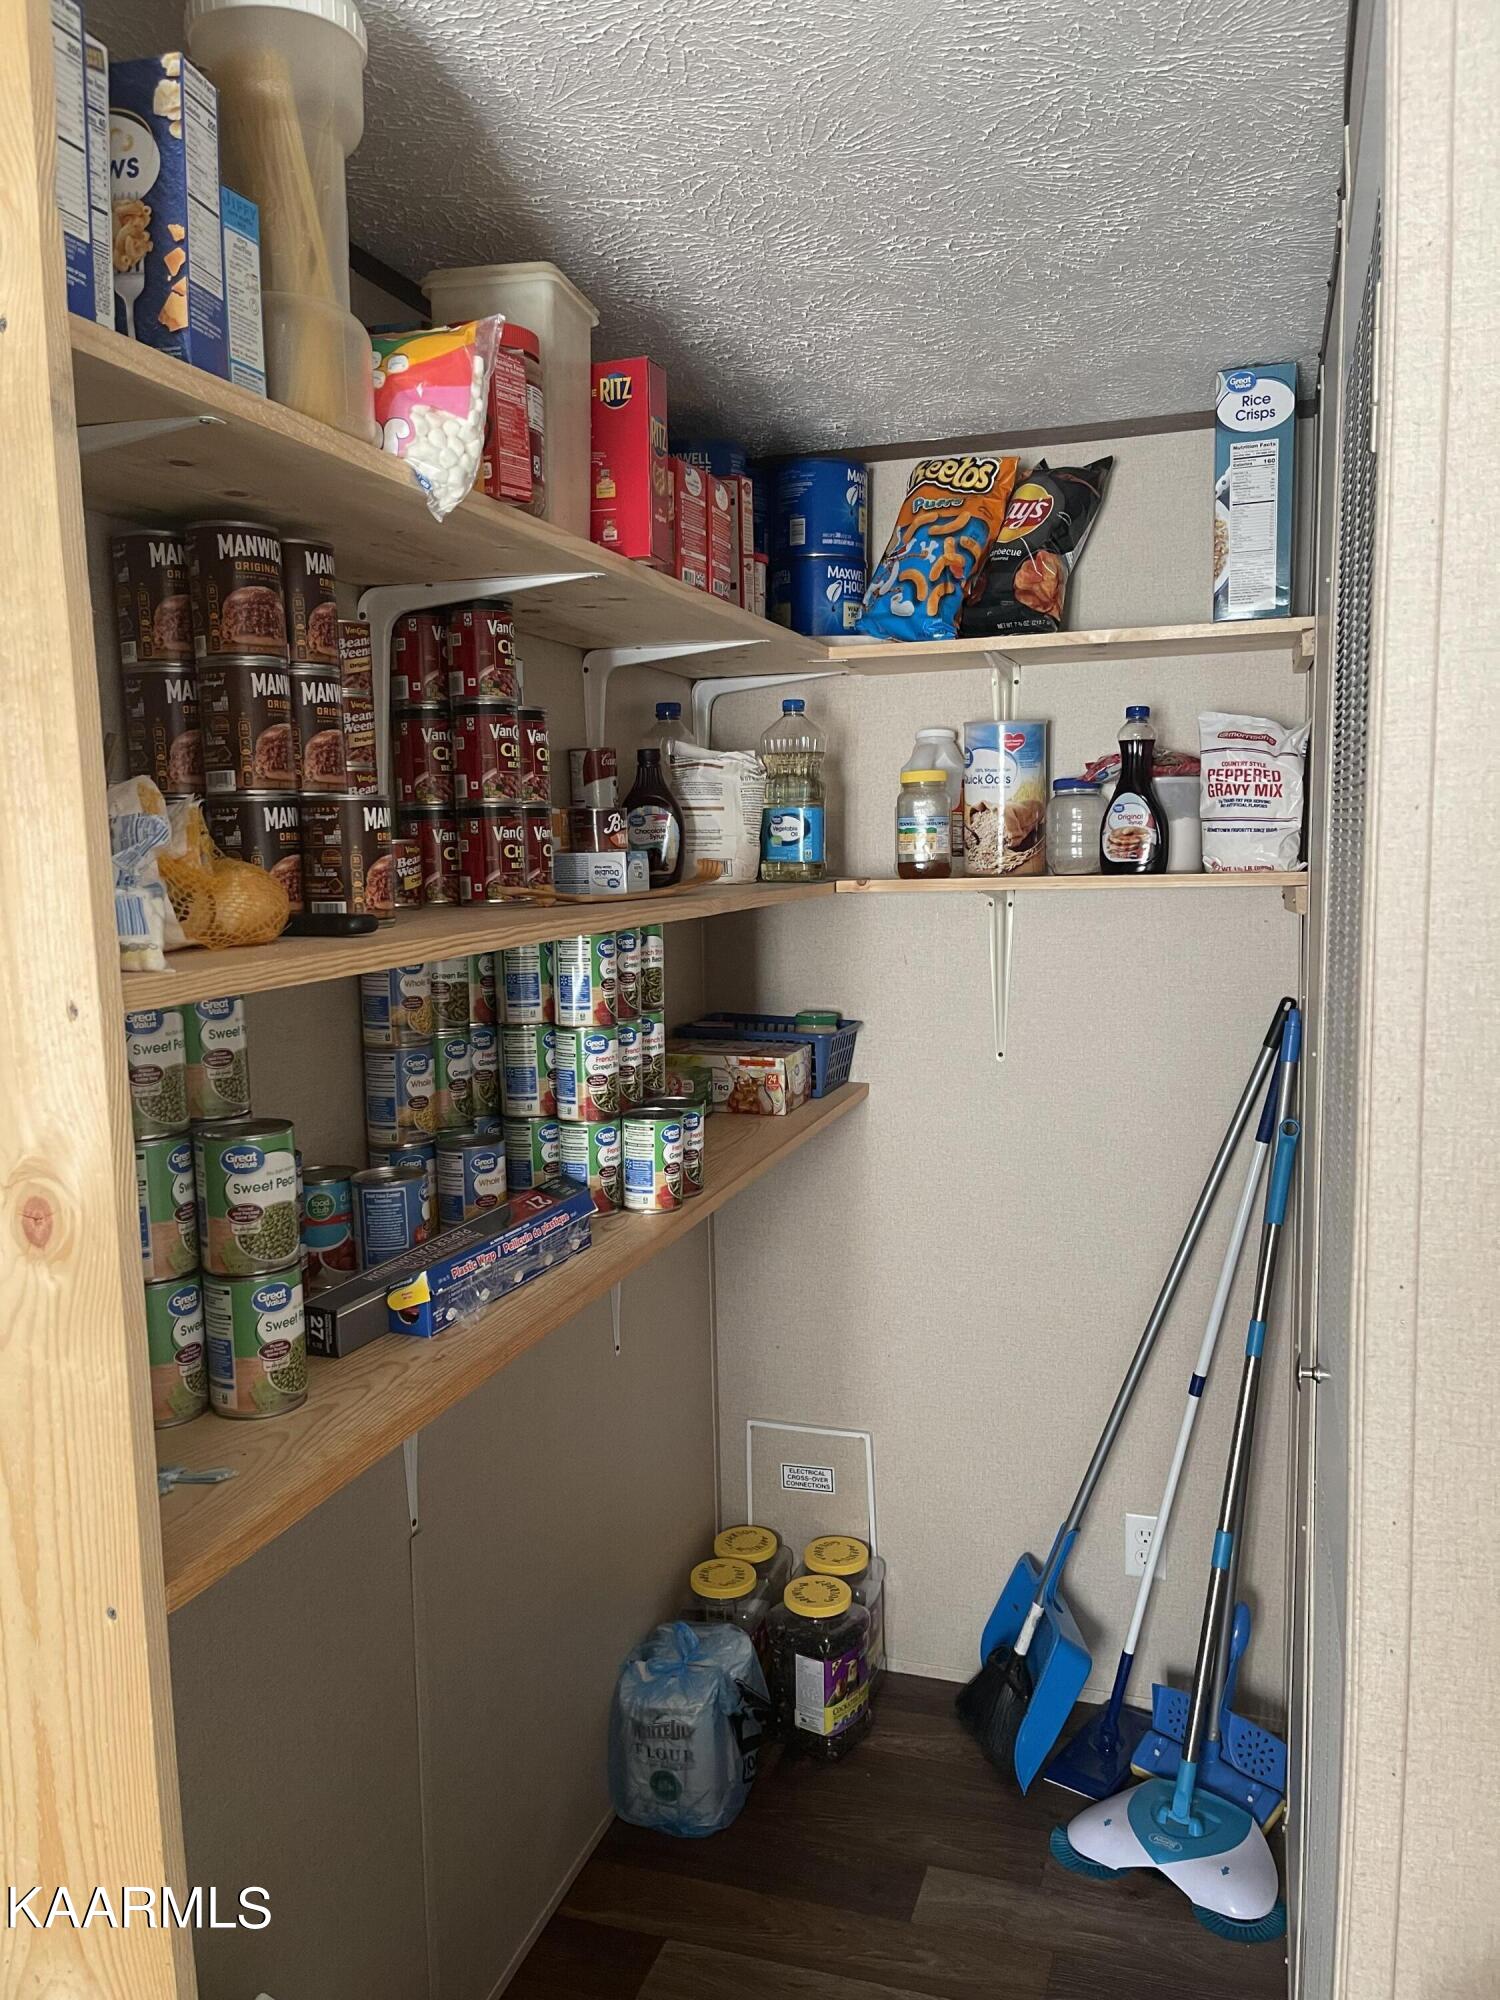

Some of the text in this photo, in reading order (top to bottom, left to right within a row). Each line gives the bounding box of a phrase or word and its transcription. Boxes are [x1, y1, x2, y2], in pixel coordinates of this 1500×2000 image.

[1229, 375, 1252, 385] Great
[600, 376, 633, 403] RITZ
[1242, 395, 1272, 407] Rice
[1235, 408, 1276, 421] Crisps
[650, 415, 667, 453] RITZ
[1232, 443, 1259, 451] Nutrition
[1007, 497, 1050, 530] ay's
[217, 534, 281, 564] MANWIC
[990, 548, 1022, 557] arbecue
[235, 561, 280, 576] ORIGINAL
[843, 582, 864, 594] HOUS
[1249, 760, 1266, 768] STYLE
[985, 773, 1011, 784] Oas
[1207, 768, 1281, 783] PEPPERED
[1207, 783, 1283, 798] GRAVY MIX
[1117, 814, 1144, 822] Original
[594, 869, 619, 877] Double
[617, 938, 635, 947] Great
[431, 971, 456, 980] Green
[404, 978, 427, 988] Whole
[200, 997, 230, 1010] Great
[208, 1026, 241, 1040] Sweet
[472, 1036, 491, 1044] Great
[585, 1039, 606, 1048] Great
[132, 1040, 172, 1056] Sweet
[447, 1044, 466, 1053] Great
[406, 1059, 427, 1068] Great
[595, 1055, 615, 1063] French
[592, 1062, 613, 1071] Green
[410, 1079, 432, 1088] Whole
[767, 1074, 777, 1084] 24
[713, 1082, 729, 1091] Tea
[684, 1115, 700, 1125] Great
[598, 1131, 616, 1140] Great
[664, 1129, 680, 1139] Great
[225, 1151, 258, 1164] Great
[233, 1160, 259, 1169] Value
[474, 1158, 495, 1168] Great
[233, 1179, 274, 1195] Sweet
[478, 1176, 500, 1188] Whole
[312, 1207, 330, 1216] club
[436, 1228, 471, 1249] PAPIER
[450, 1260, 478, 1280] Plastic
[475, 1251, 498, 1267] Wrap
[502, 1232, 534, 1254] Pellicule
[532, 1227, 542, 1239] de
[540, 1212, 570, 1235] plastique
[172, 1292, 198, 1307] Great
[257, 1288, 287, 1302] Great
[265, 1297, 288, 1307] Value
[265, 1315, 298, 1332] Sweet
[309, 1315, 325, 1341] 27
[788, 1467, 826, 1477] ELECTRICAL
[787, 1473, 829, 1484] CROSS-OVER
[785, 1480, 831, 1490] CONNECTIONS
[634, 1742, 695, 1763] FLOUR
